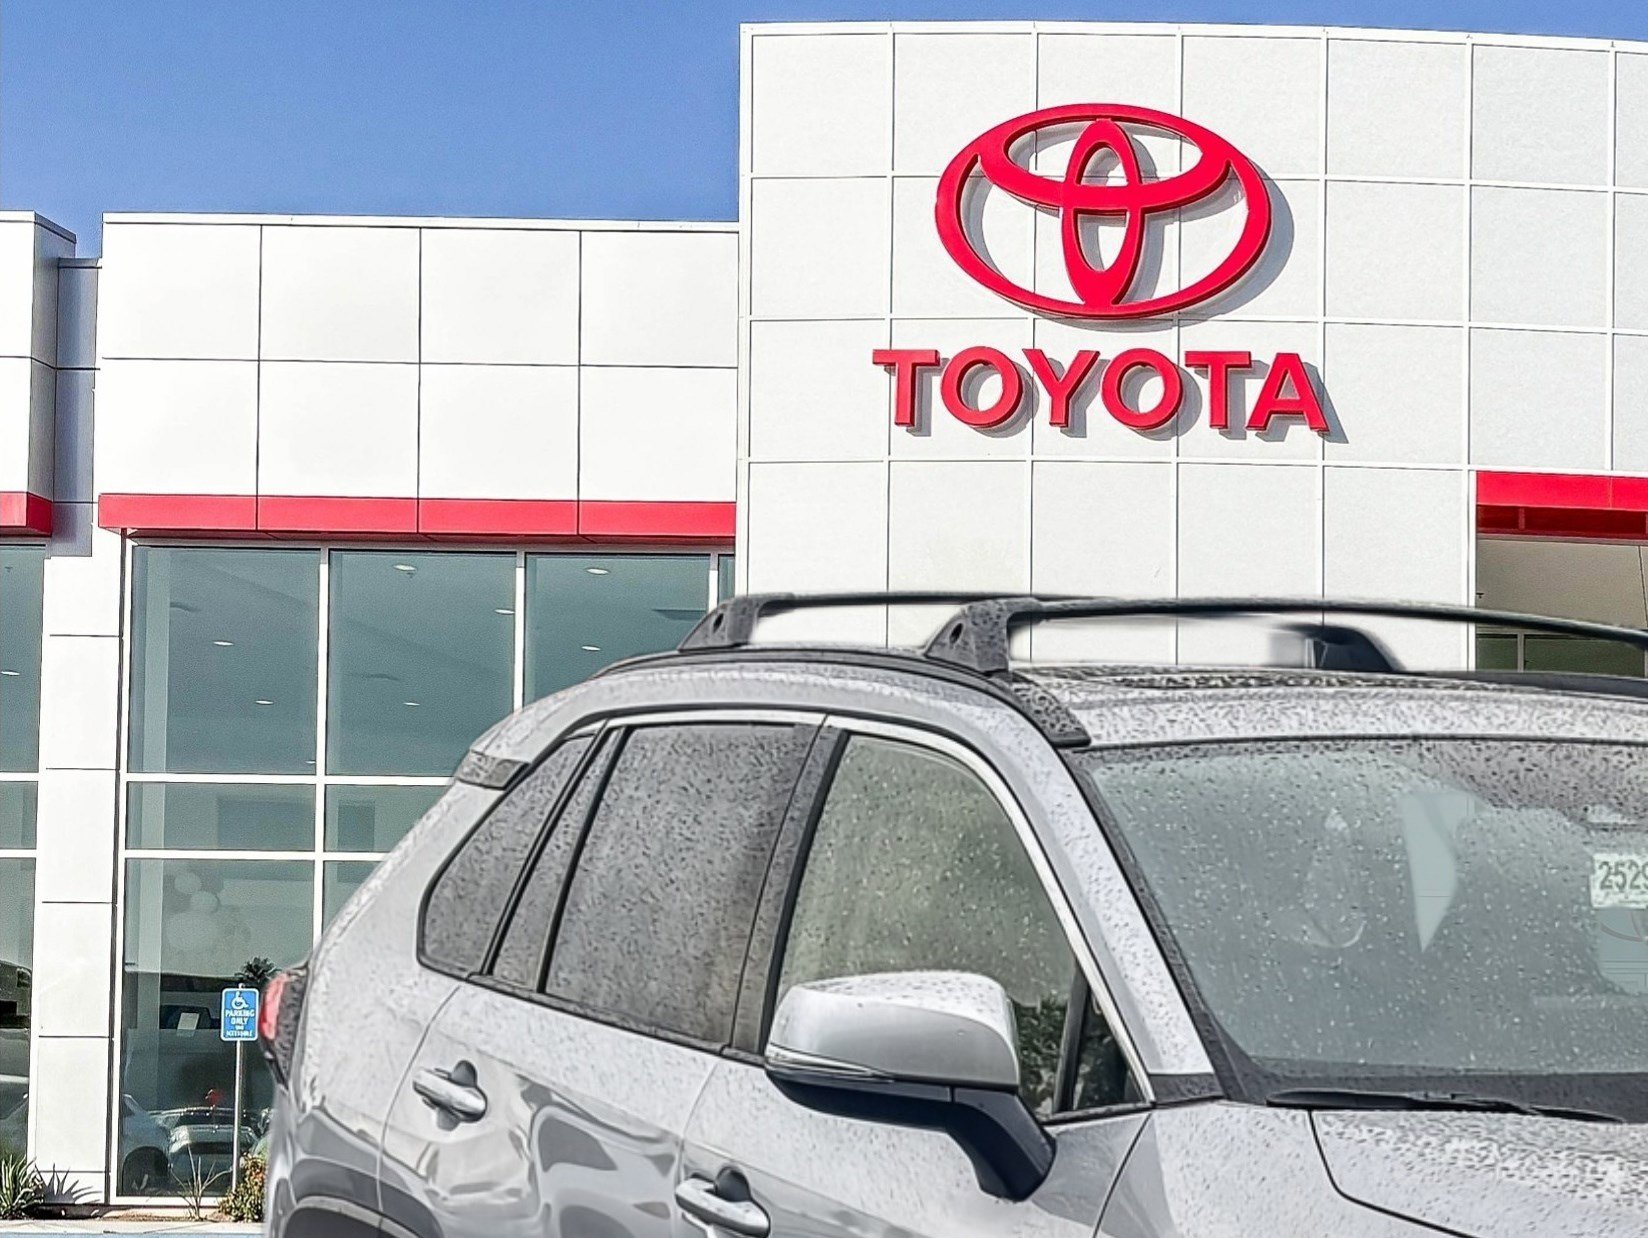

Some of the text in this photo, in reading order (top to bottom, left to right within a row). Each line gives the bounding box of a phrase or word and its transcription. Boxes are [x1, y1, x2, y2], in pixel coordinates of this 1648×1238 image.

[873, 345, 1330, 432] TOYOTA
[225, 1009, 256, 1018] PARKING
[230, 1017, 249, 1025] ONLY
